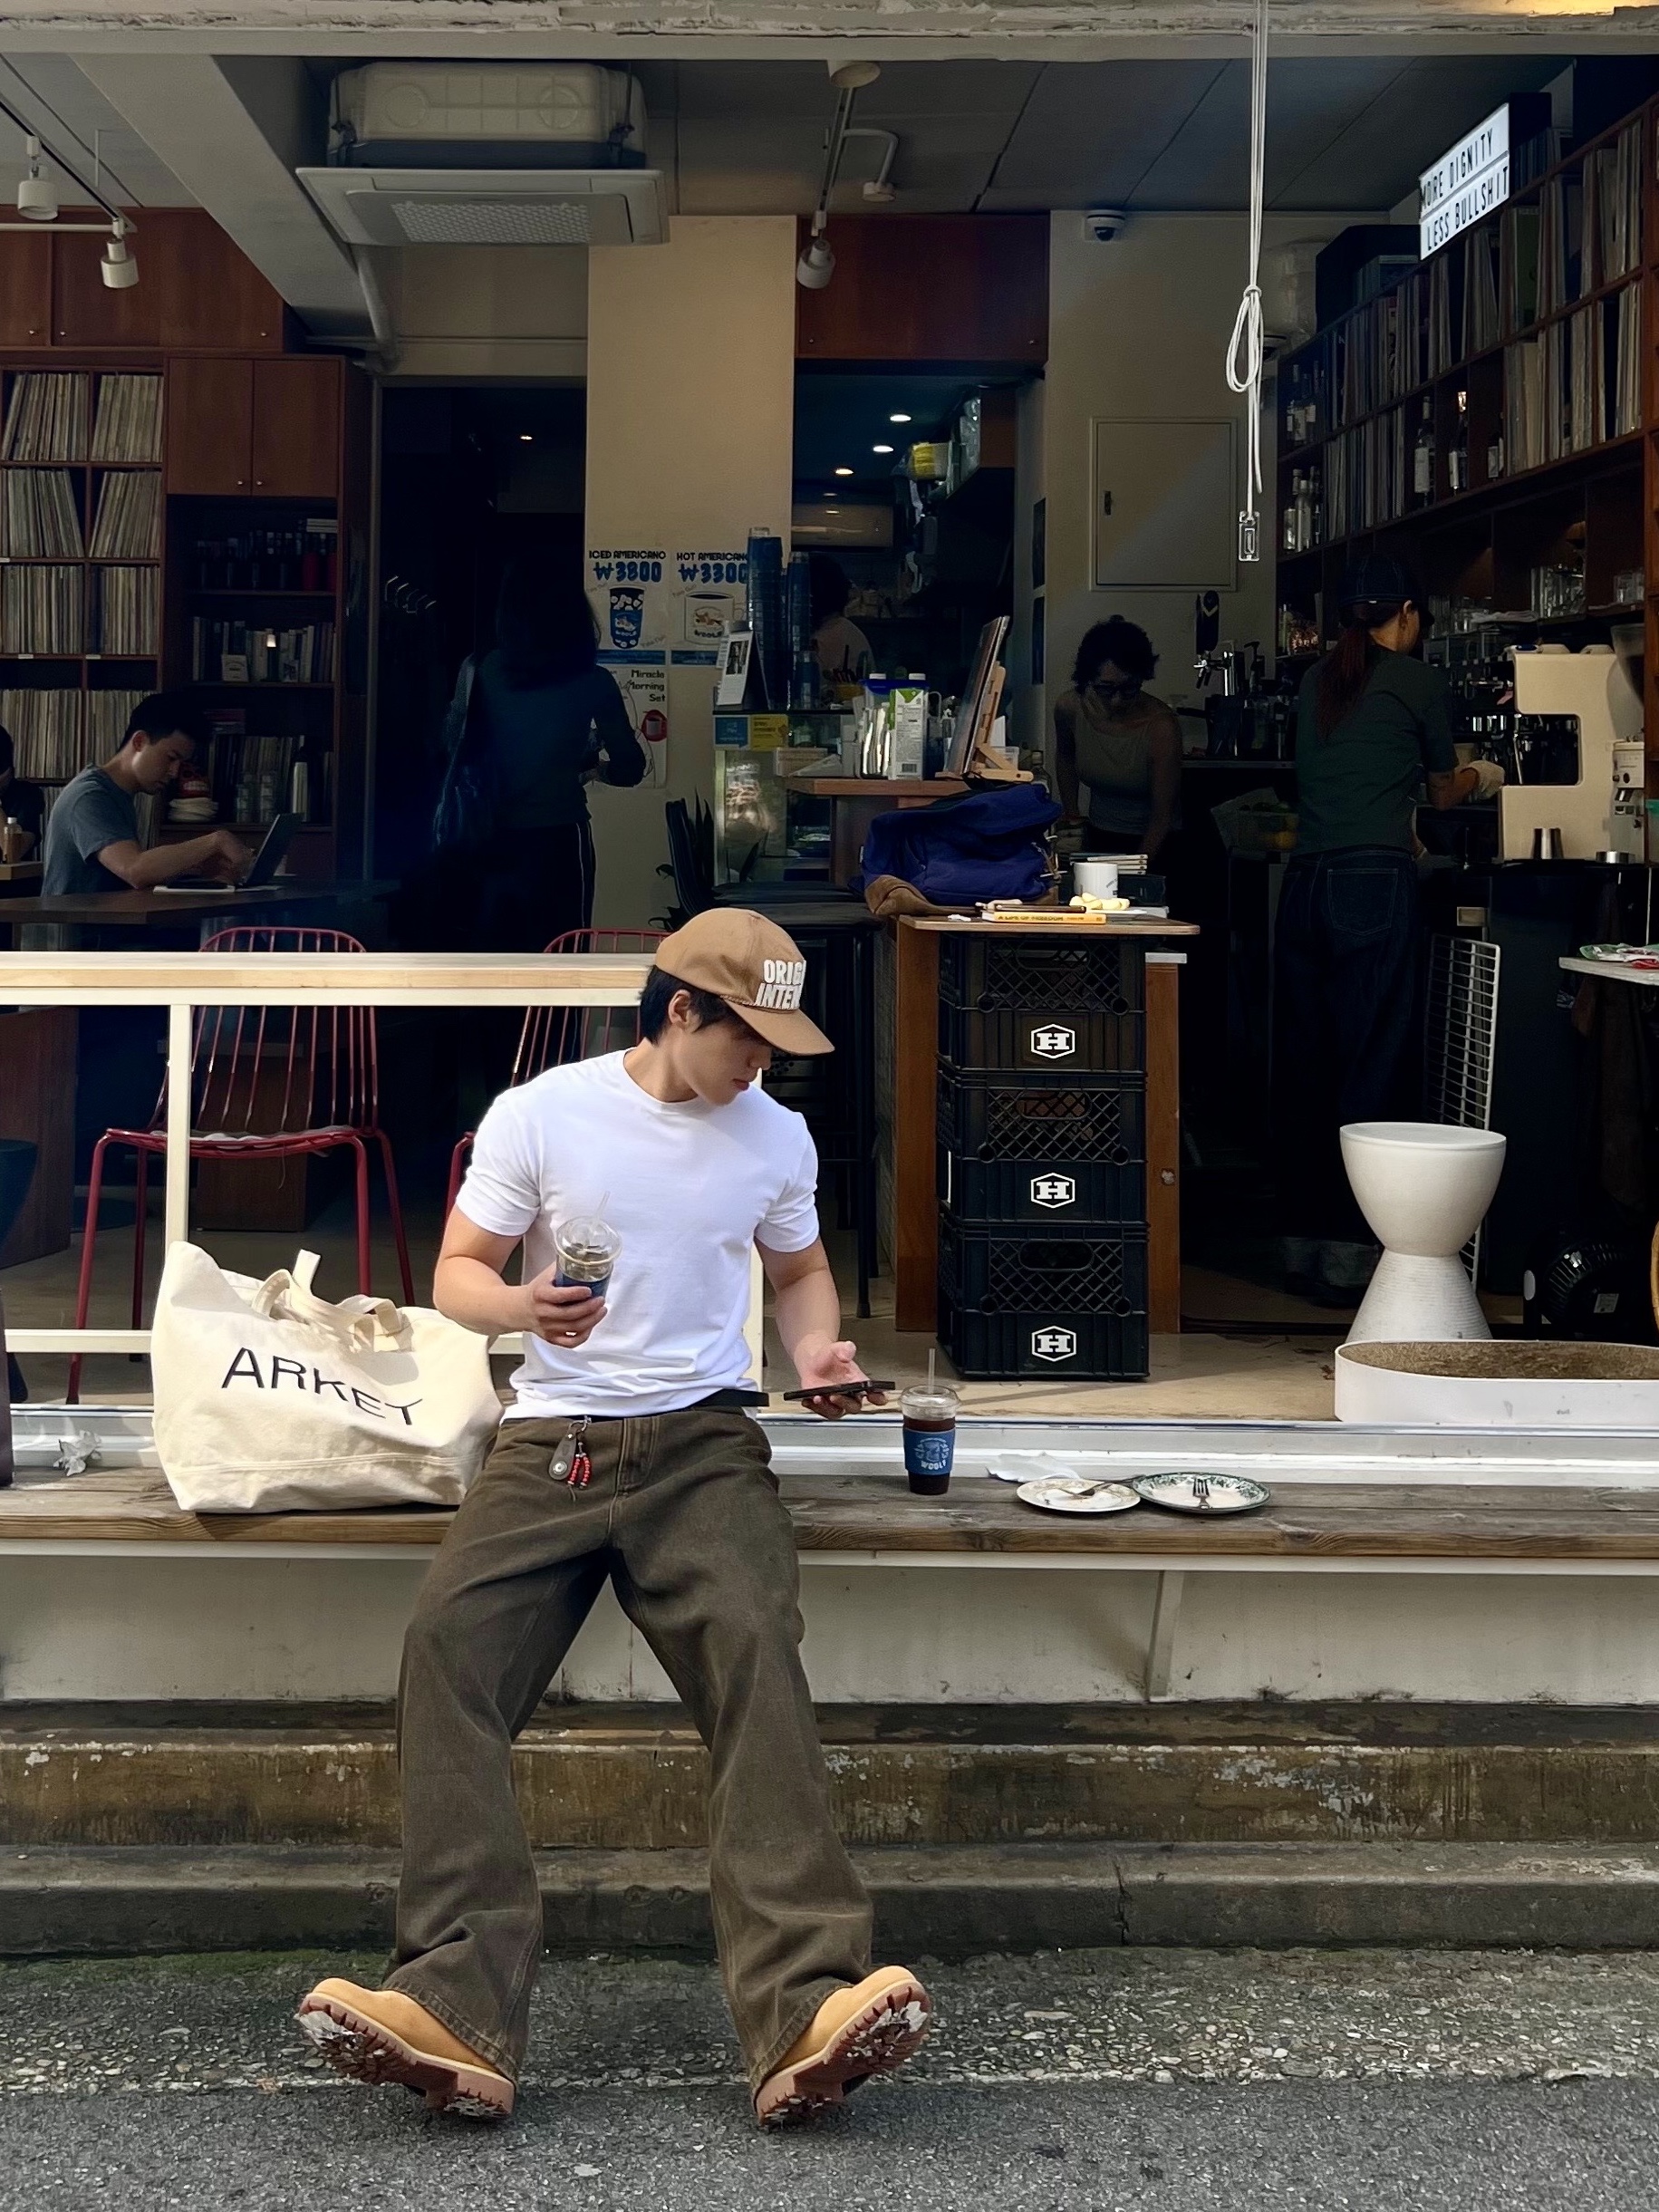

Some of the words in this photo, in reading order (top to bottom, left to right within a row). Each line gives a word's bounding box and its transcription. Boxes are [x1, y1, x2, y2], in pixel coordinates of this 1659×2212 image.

[1420, 170, 1443, 209] MORE
[1450, 127, 1493, 188] DIGNITY
[1427, 212, 1449, 251] LESS
[1455, 166, 1509, 229] BULLSHIT
[589, 549, 612, 559] ICED
[613, 549, 667, 559] AMERICANO
[677, 552, 696, 561] HOT
[631, 669, 665, 678] Miracle
[649, 693, 665, 701] Set
[764, 959, 806, 985] ORIG
[1037, 1033, 1070, 1050] H
[1037, 1182, 1070, 1199] H
[1037, 1335, 1071, 1352] H
[221, 1347, 423, 1425] ARKEY
